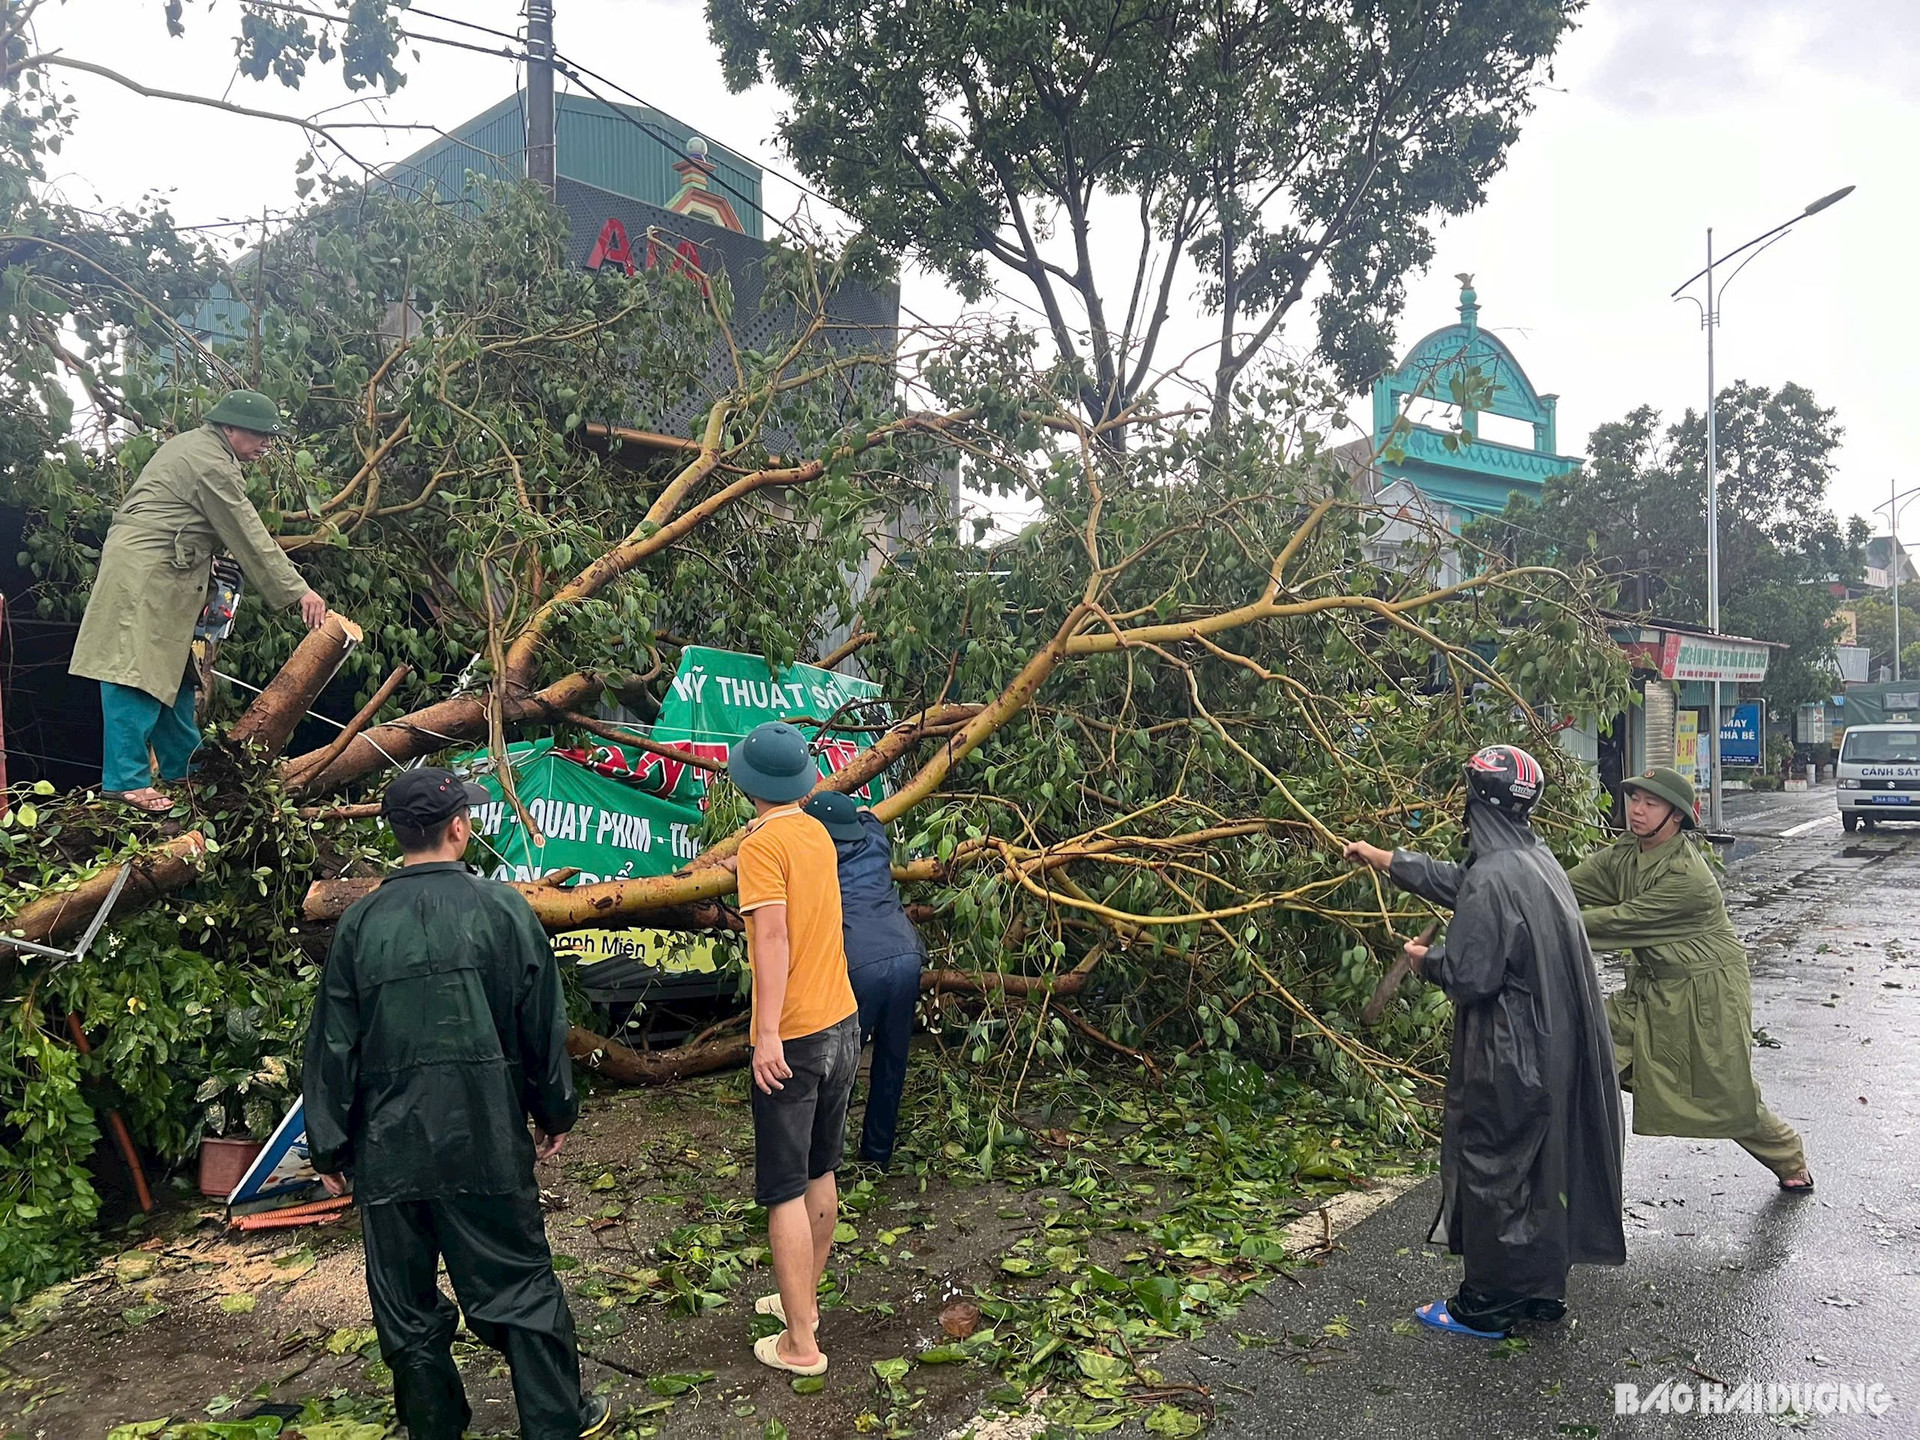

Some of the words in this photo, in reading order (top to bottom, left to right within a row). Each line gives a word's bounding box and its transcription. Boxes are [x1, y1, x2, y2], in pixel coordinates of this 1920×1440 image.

[1861, 765, 1894, 776] CẢNH
[528, 797, 594, 842] QUAY
[596, 809, 650, 853] PHIM
